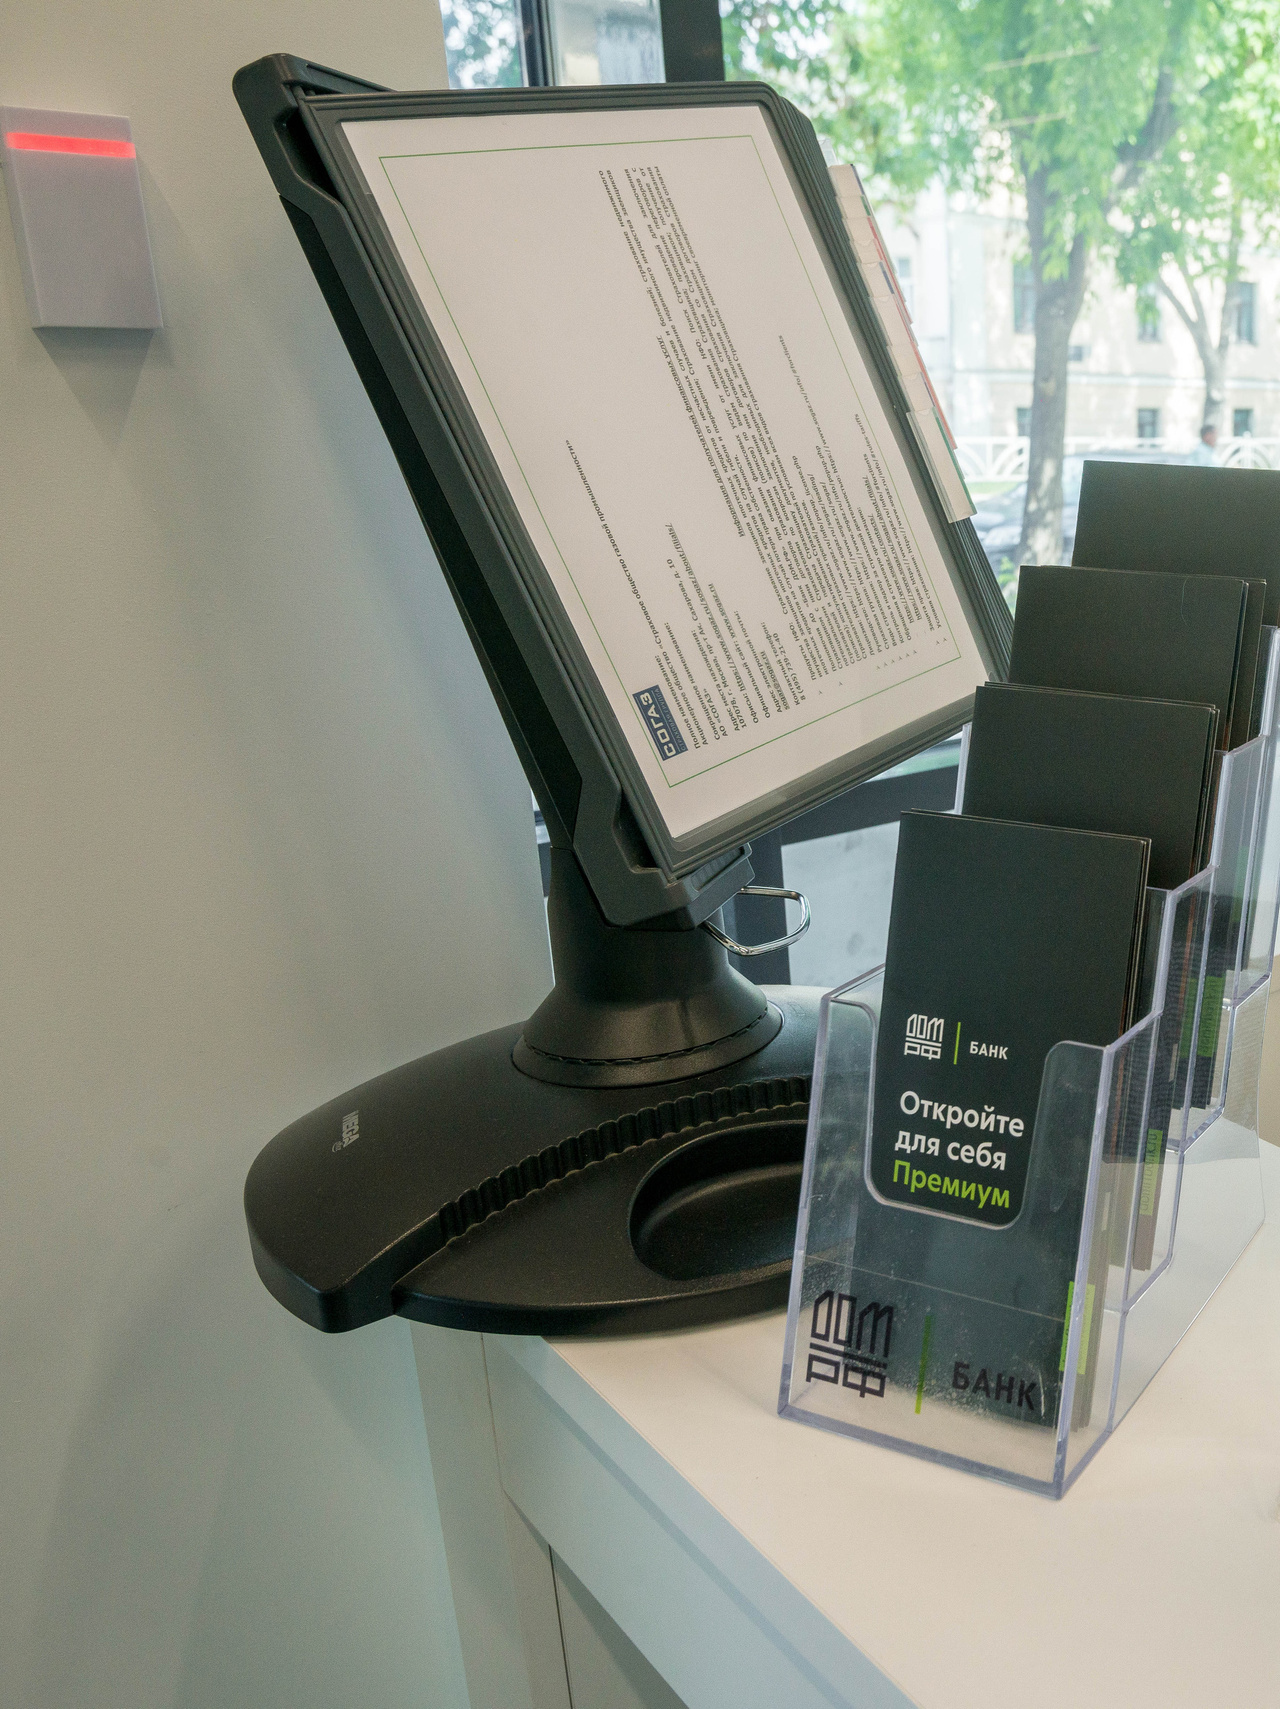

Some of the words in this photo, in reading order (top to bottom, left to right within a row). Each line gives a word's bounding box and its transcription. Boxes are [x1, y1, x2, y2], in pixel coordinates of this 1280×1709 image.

[563, 438, 607, 522] промышленности»
[600, 522, 623, 558] газовой
[616, 557, 642, 600] общество
[636, 599, 665, 650] «Страховое
[701, 635, 715, 655] пр-т
[659, 650, 684, 692] общество
[744, 638, 772, 689] электронной
[771, 631, 793, 672] 739-21-40
[714, 682, 729, 707] места
[740, 661, 772, 719] Официальный
[767, 689, 783, 714] Адрес
[775, 658, 800, 706] Контактный
[788, 671, 804, 695] (495)
[640, 692, 676, 757] СОГАЗ
[678, 691, 709, 746] Акционерное
[690, 684, 722, 741] Сокращенное
[700, 687, 722, 724] «СОГАЗ»
[724, 706, 741, 733] Адрес
[681, 717, 701, 749] Полное
[905, 1013, 945, 1042] ДОМ
[904, 1042, 942, 1060] РФ
[969, 1041, 1009, 1060] БАНК
[899, 1090, 1025, 1138] Откройте
[894, 1130, 940, 1156] для
[946, 1141, 1007, 1171] себя
[892, 1159, 1010, 1209] Премиум
[810, 1290, 894, 1358] ДОМ
[805, 1353, 887, 1398] РФ
[951, 1361, 1039, 1411] БАНК
